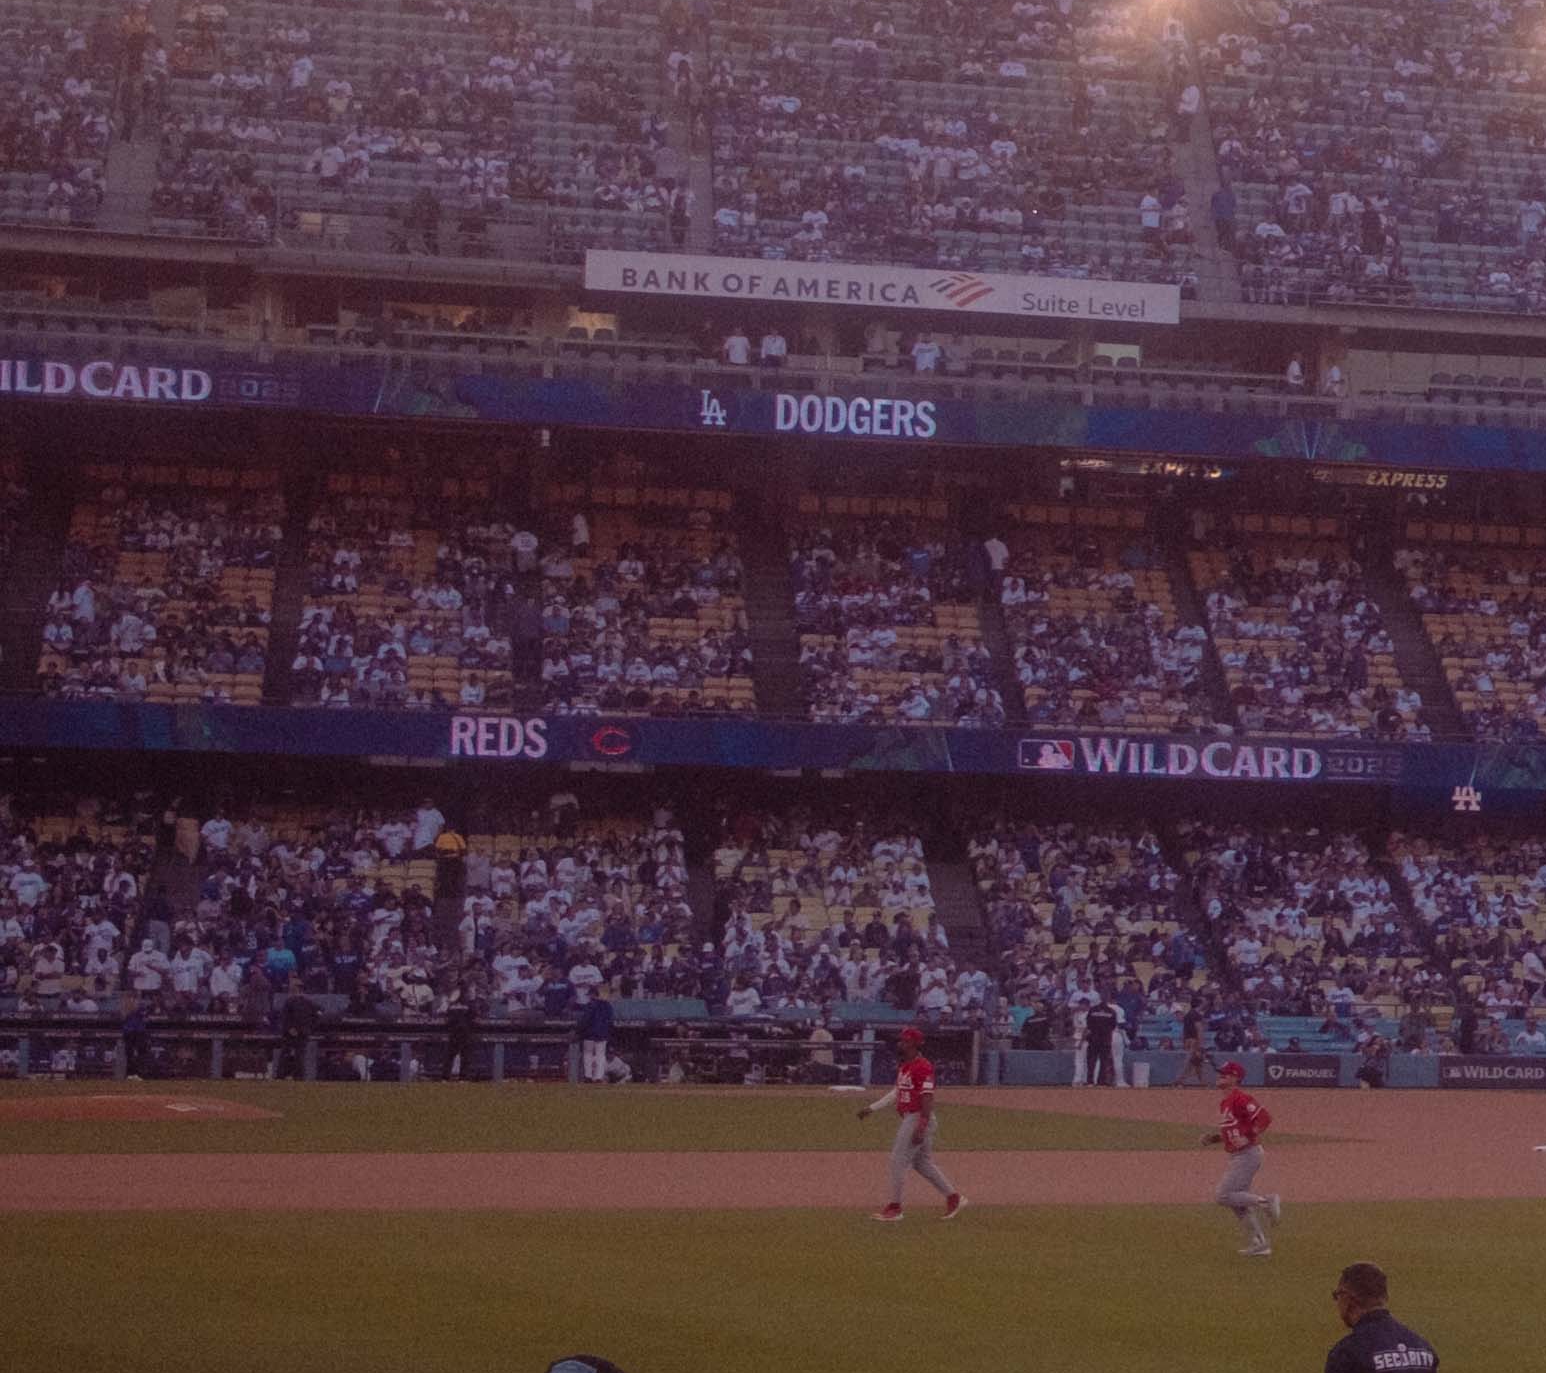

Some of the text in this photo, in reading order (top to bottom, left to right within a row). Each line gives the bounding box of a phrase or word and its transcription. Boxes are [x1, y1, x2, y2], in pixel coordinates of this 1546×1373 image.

[622, 267, 921, 304] BANK OF AMERICA
[1021, 290, 1146, 318] Suite Level
[776, 393, 938, 438] DODGERS
[1366, 470, 1448, 490] EXPRESS
[451, 715, 549, 759] REDS
[1285, 1068, 1336, 1079] FANDUEL
[1373, 1349, 1435, 1372] SECURITY
